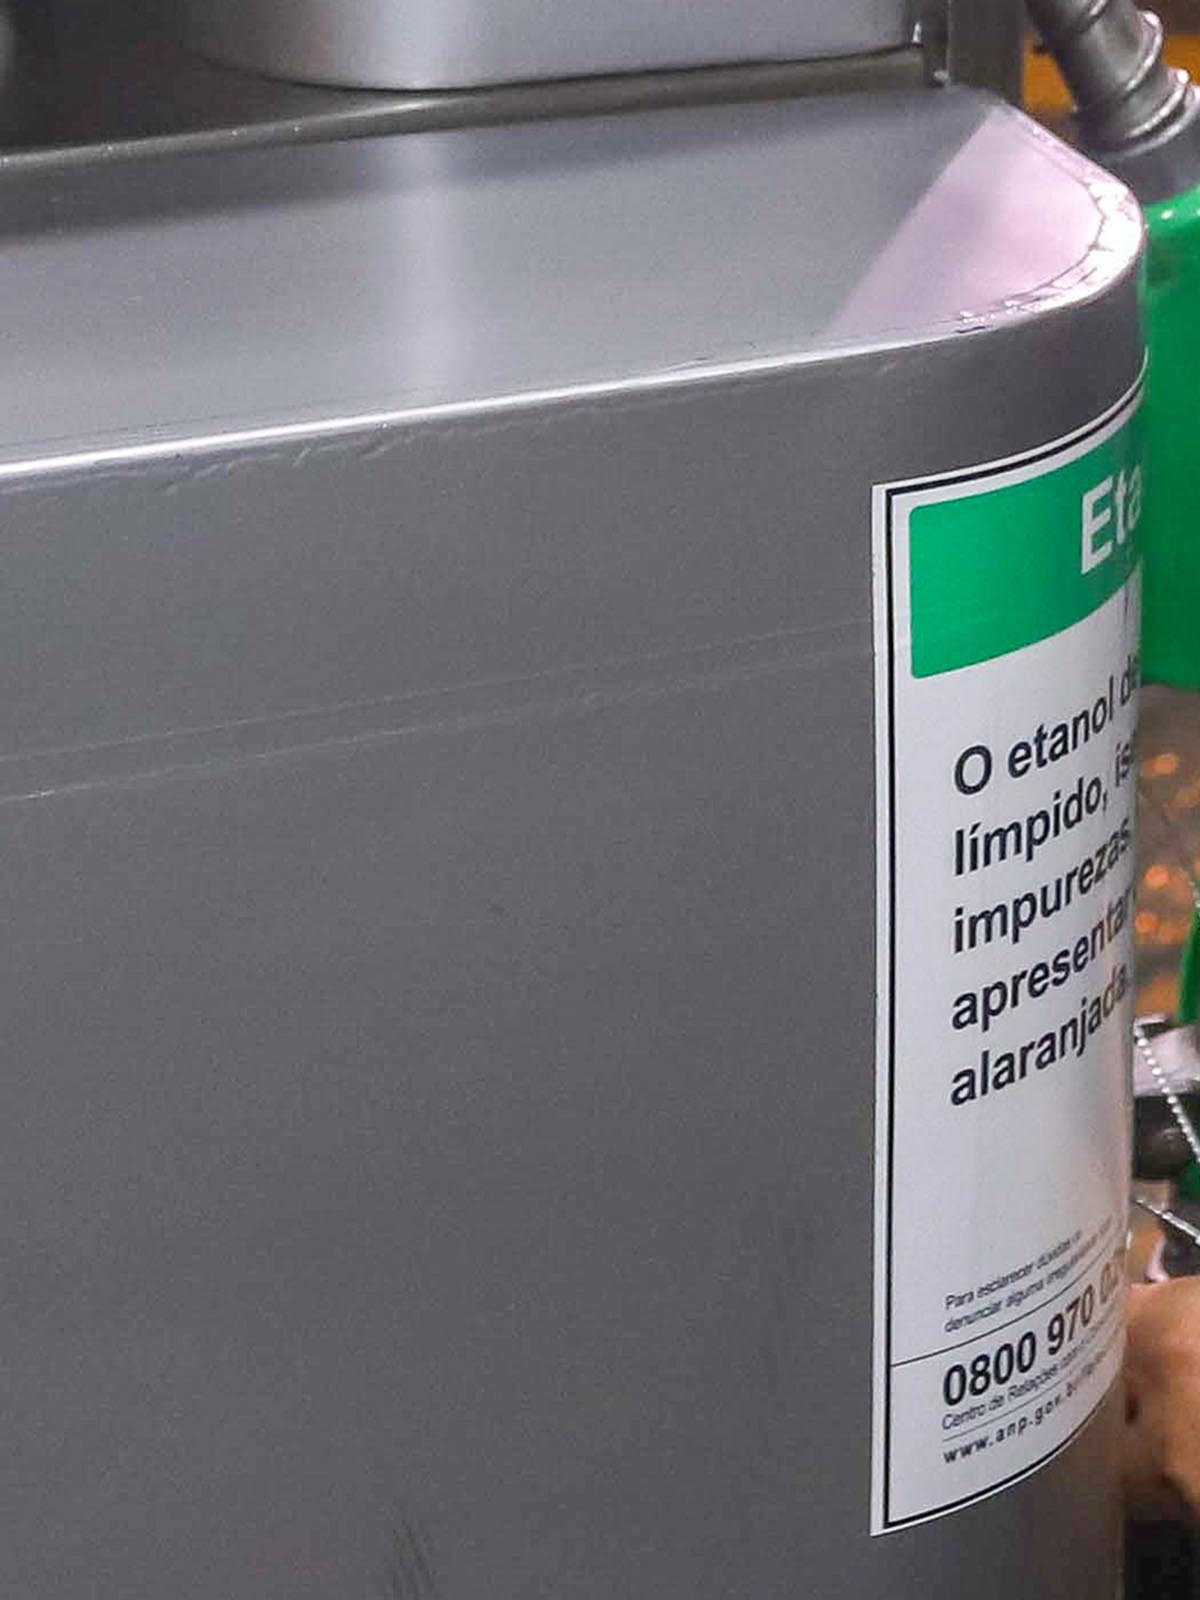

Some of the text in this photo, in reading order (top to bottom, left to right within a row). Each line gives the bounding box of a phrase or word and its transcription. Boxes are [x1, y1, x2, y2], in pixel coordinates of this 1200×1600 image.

[954, 745, 993, 795] O
[1008, 675, 1114, 778] etanol
[955, 777, 1108, 876] límpido,
[955, 817, 1131, 953] impurezas
[943, 1331, 1037, 1406] 0800
[1047, 1284, 1094, 1355] 970
[945, 1291, 974, 1310] Para
[942, 1403, 986, 1430] Centro
[988, 1395, 1004, 1411] de
